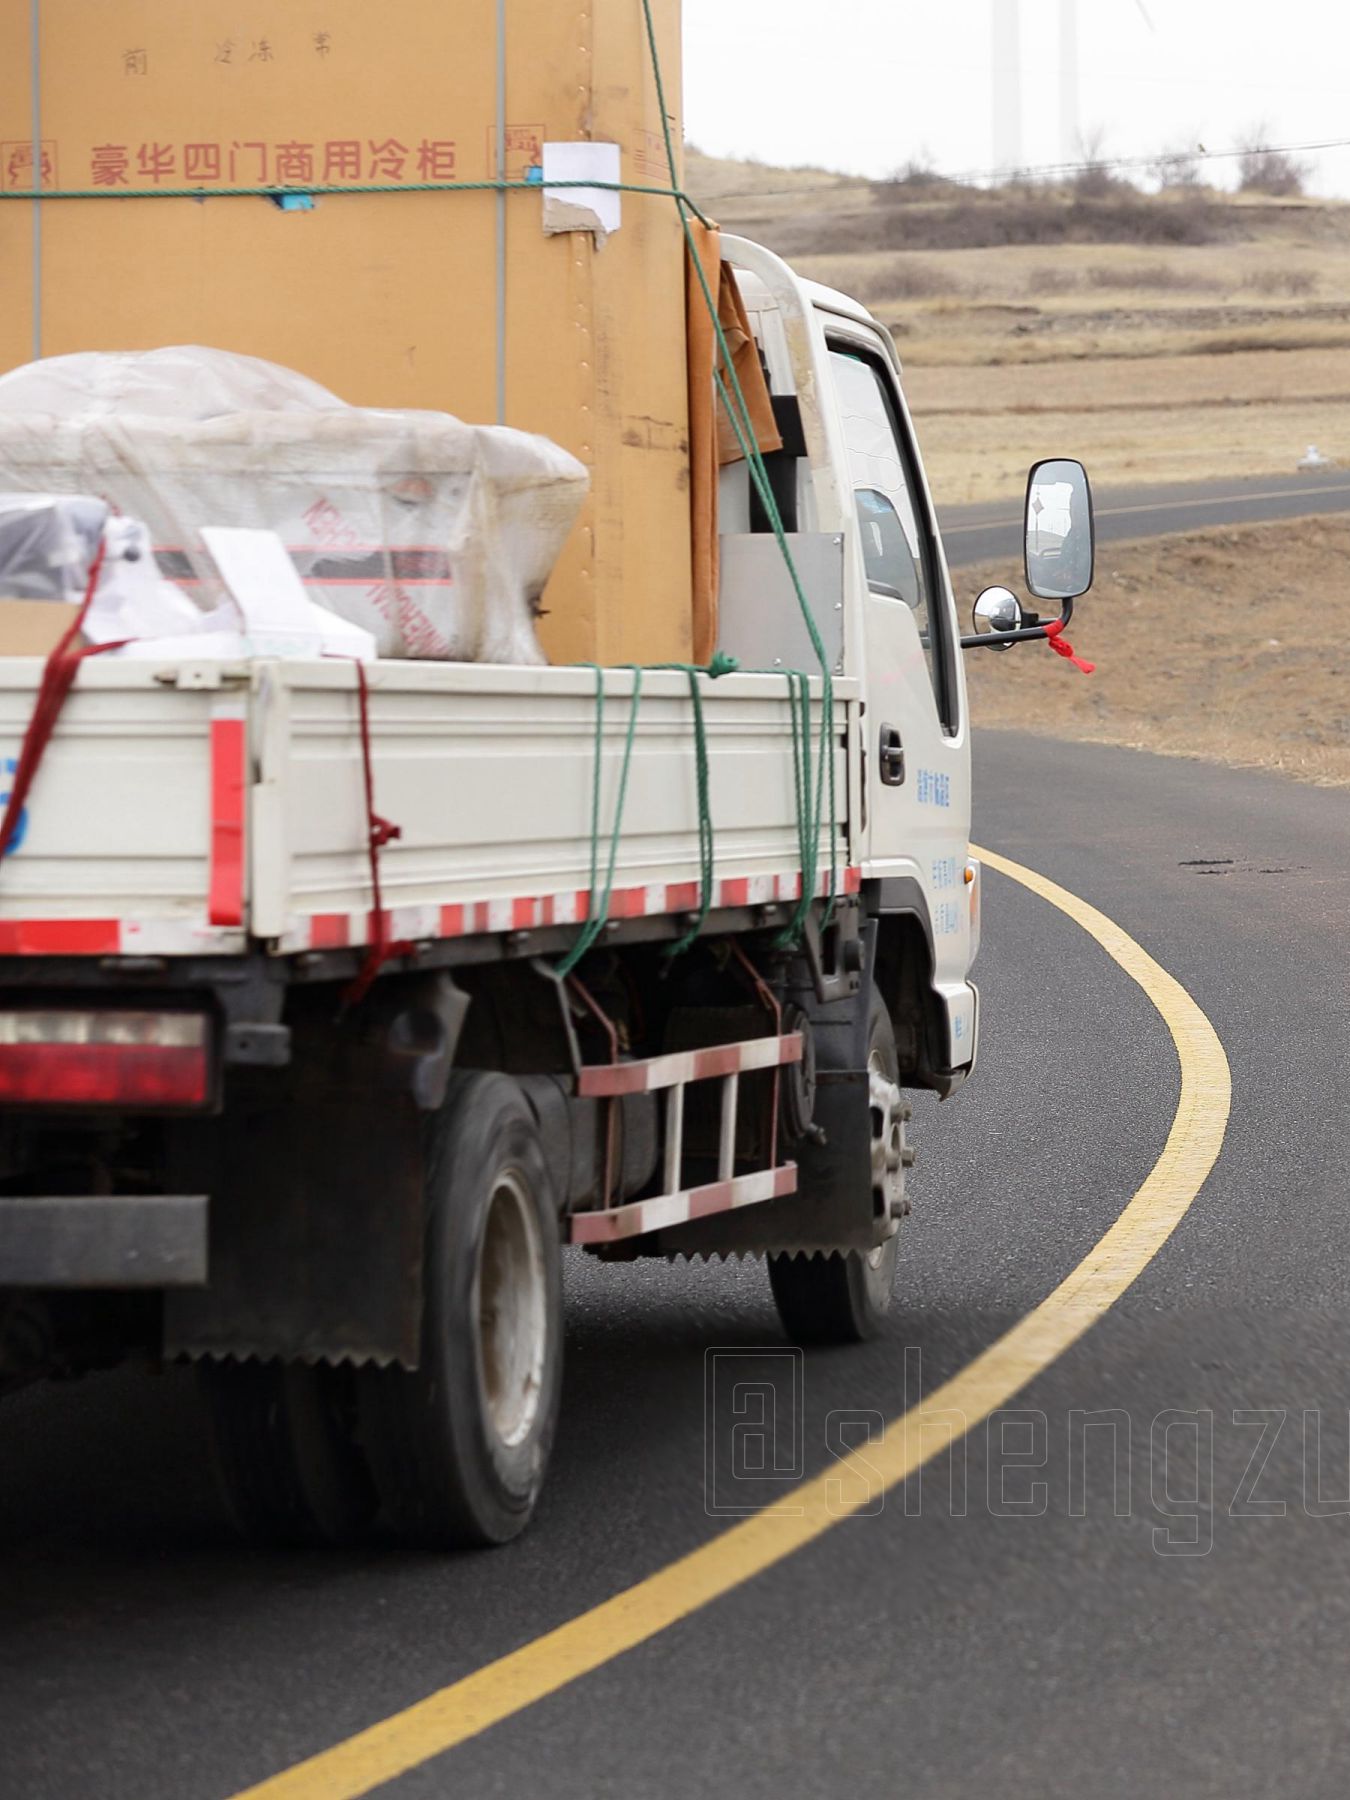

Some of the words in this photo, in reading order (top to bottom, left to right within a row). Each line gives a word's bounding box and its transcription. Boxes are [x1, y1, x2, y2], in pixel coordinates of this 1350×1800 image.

[90, 138, 457, 187] 豪华四门商用冷柜
